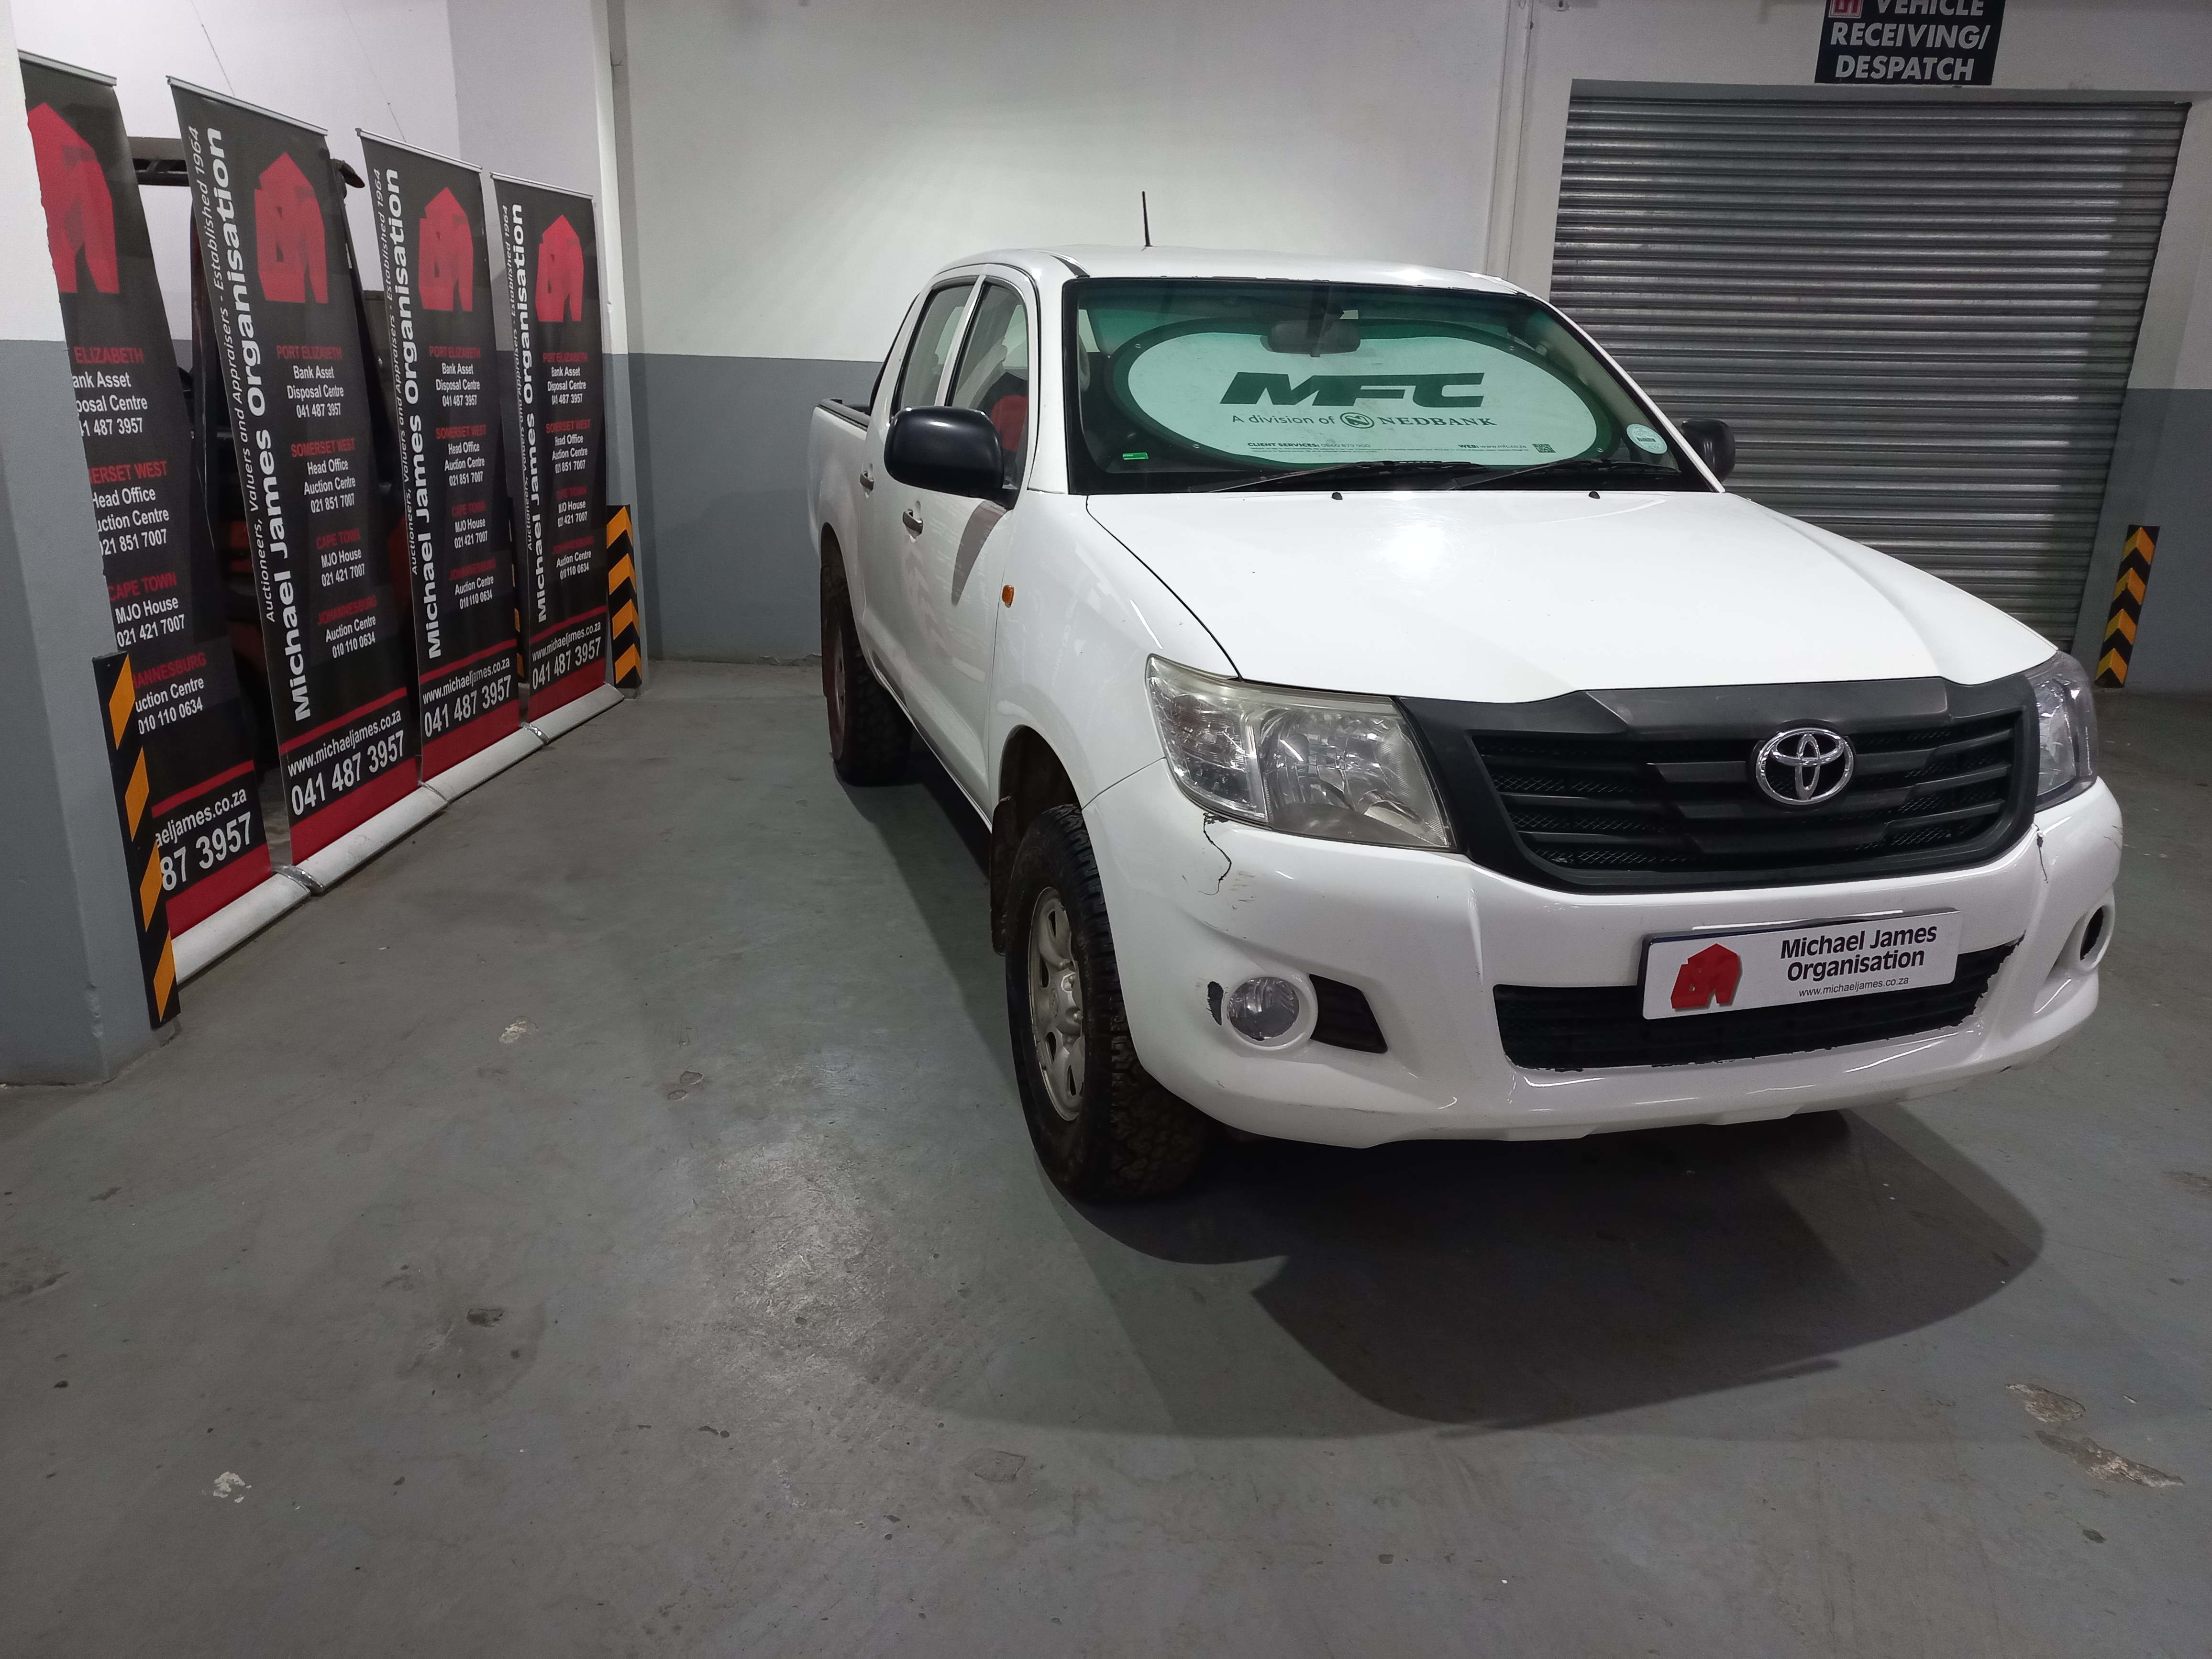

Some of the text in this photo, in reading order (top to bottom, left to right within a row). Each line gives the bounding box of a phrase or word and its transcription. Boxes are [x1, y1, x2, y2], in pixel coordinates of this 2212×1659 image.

[1877, 0, 1984, 16] VEHICLE
[1830, 22, 1991, 50] RECEIVING/
[1835, 55, 1975, 81] DESPATCH
[512, 204, 533, 404] Organisation
[74, 346, 144, 363] ELIZABETH
[72, 371, 132, 388] ank Asset
[188, 126, 275, 623] Auctioneers, Valuers and Appraisers Established 1964
[293, 365, 335, 379] Bank Asset
[442, 363, 474, 375] Bank Asset
[287, 384, 344, 401] Disposal Centre
[436, 379, 461, 393] Disposal
[1220, 372, 1485, 407] MFC
[76, 395, 148, 417] posal Centre
[453, 395, 463, 406] 487
[465, 395, 477, 406] 3957
[559, 394, 569, 404] 487
[296, 403, 341, 418] 041 487 3957
[386, 169, 441, 659] Michael James Organisation
[1232, 414, 1497, 426] A division of NEDBANK
[94, 419, 112, 435] 487
[117, 417, 143, 434] 3957
[207, 128, 310, 721] Michael James Organisation
[448, 442, 480, 454] Head Office
[567, 434, 584, 444] Office
[307, 458, 348, 475] Head Office
[444, 457, 485, 471] Auction Centre
[527, 413, 540, 506] James
[562, 461, 572, 472] 851
[88, 460, 167, 485] ERSET WEST
[449, 475, 458, 487] 021
[459, 473, 469, 485] 851
[122, 487, 156, 504] Office
[304, 476, 356, 495] Auction Centre
[310, 493, 354, 513] 021 851 7007
[568, 500, 586, 511] House
[97, 508, 169, 532] ction Centre
[467, 519, 486, 530] House
[564, 514, 574, 525] 421
[119, 533, 139, 552] 851
[141, 529, 167, 547] 7007
[454, 531, 488, 549] 021 421 7007
[321, 549, 361, 568] MJO House
[532, 514, 546, 622] Michael
[321, 563, 365, 587] 021 421 7007
[567, 565, 575, 576] 110
[142, 572, 177, 593] TOWN
[455, 575, 494, 595] Auction Centre
[469, 589, 492, 605] 110 0634
[115, 597, 178, 624] MJO House
[117, 614, 185, 647] 021 421 7007
[326, 615, 376, 643] Auction Centre
[332, 631, 375, 658] 010 110 0634
[133, 652, 207, 689] ANNESBURG
[532, 637, 601, 690] 041 487 3957
[423, 658, 510, 705] www.michaeljames.co.za
[135, 678, 204, 712] uction Centre
[138, 697, 203, 735] 010 110 0634
[424, 675, 511, 737] 041 487 3957
[288, 710, 401, 777] www.michaeljames.co.za
[291, 730, 404, 816] 041 487 3957
[155, 788, 247, 848] aeljames.co.za
[160, 811, 251, 891] 87 3957
[1781, 925, 1937, 959] Michael James
[1787, 950, 1925, 983] Organisation
[1799, 977, 1909, 997] www.michaeljames.co.za
